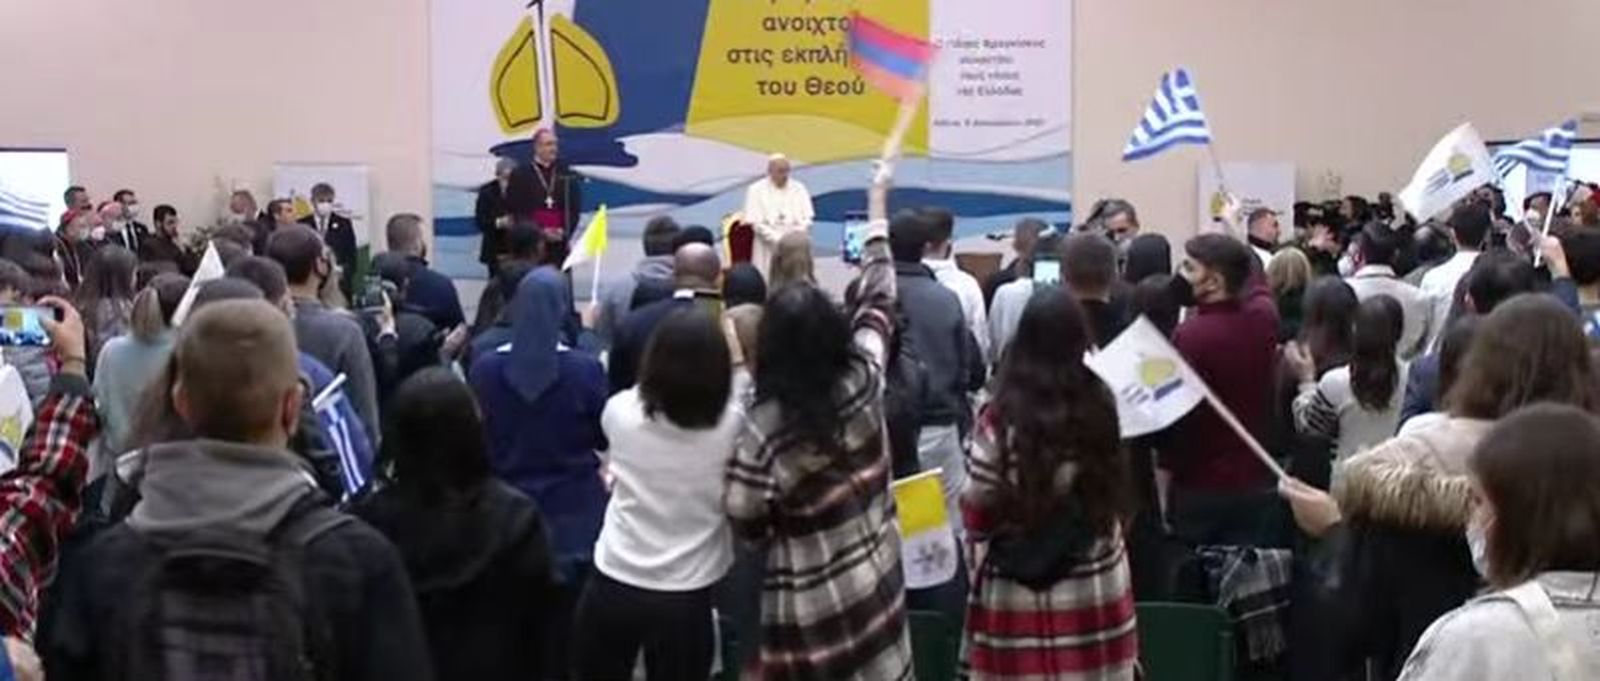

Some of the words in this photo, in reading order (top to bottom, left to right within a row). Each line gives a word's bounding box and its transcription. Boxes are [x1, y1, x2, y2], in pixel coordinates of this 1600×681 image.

[762, 15, 851, 36] ανοιχτο
[727, 48, 773, 68] στις
[781, 43, 849, 68] εκπλή
[756, 79, 797, 96] του
[804, 75, 865, 96] Θεού
